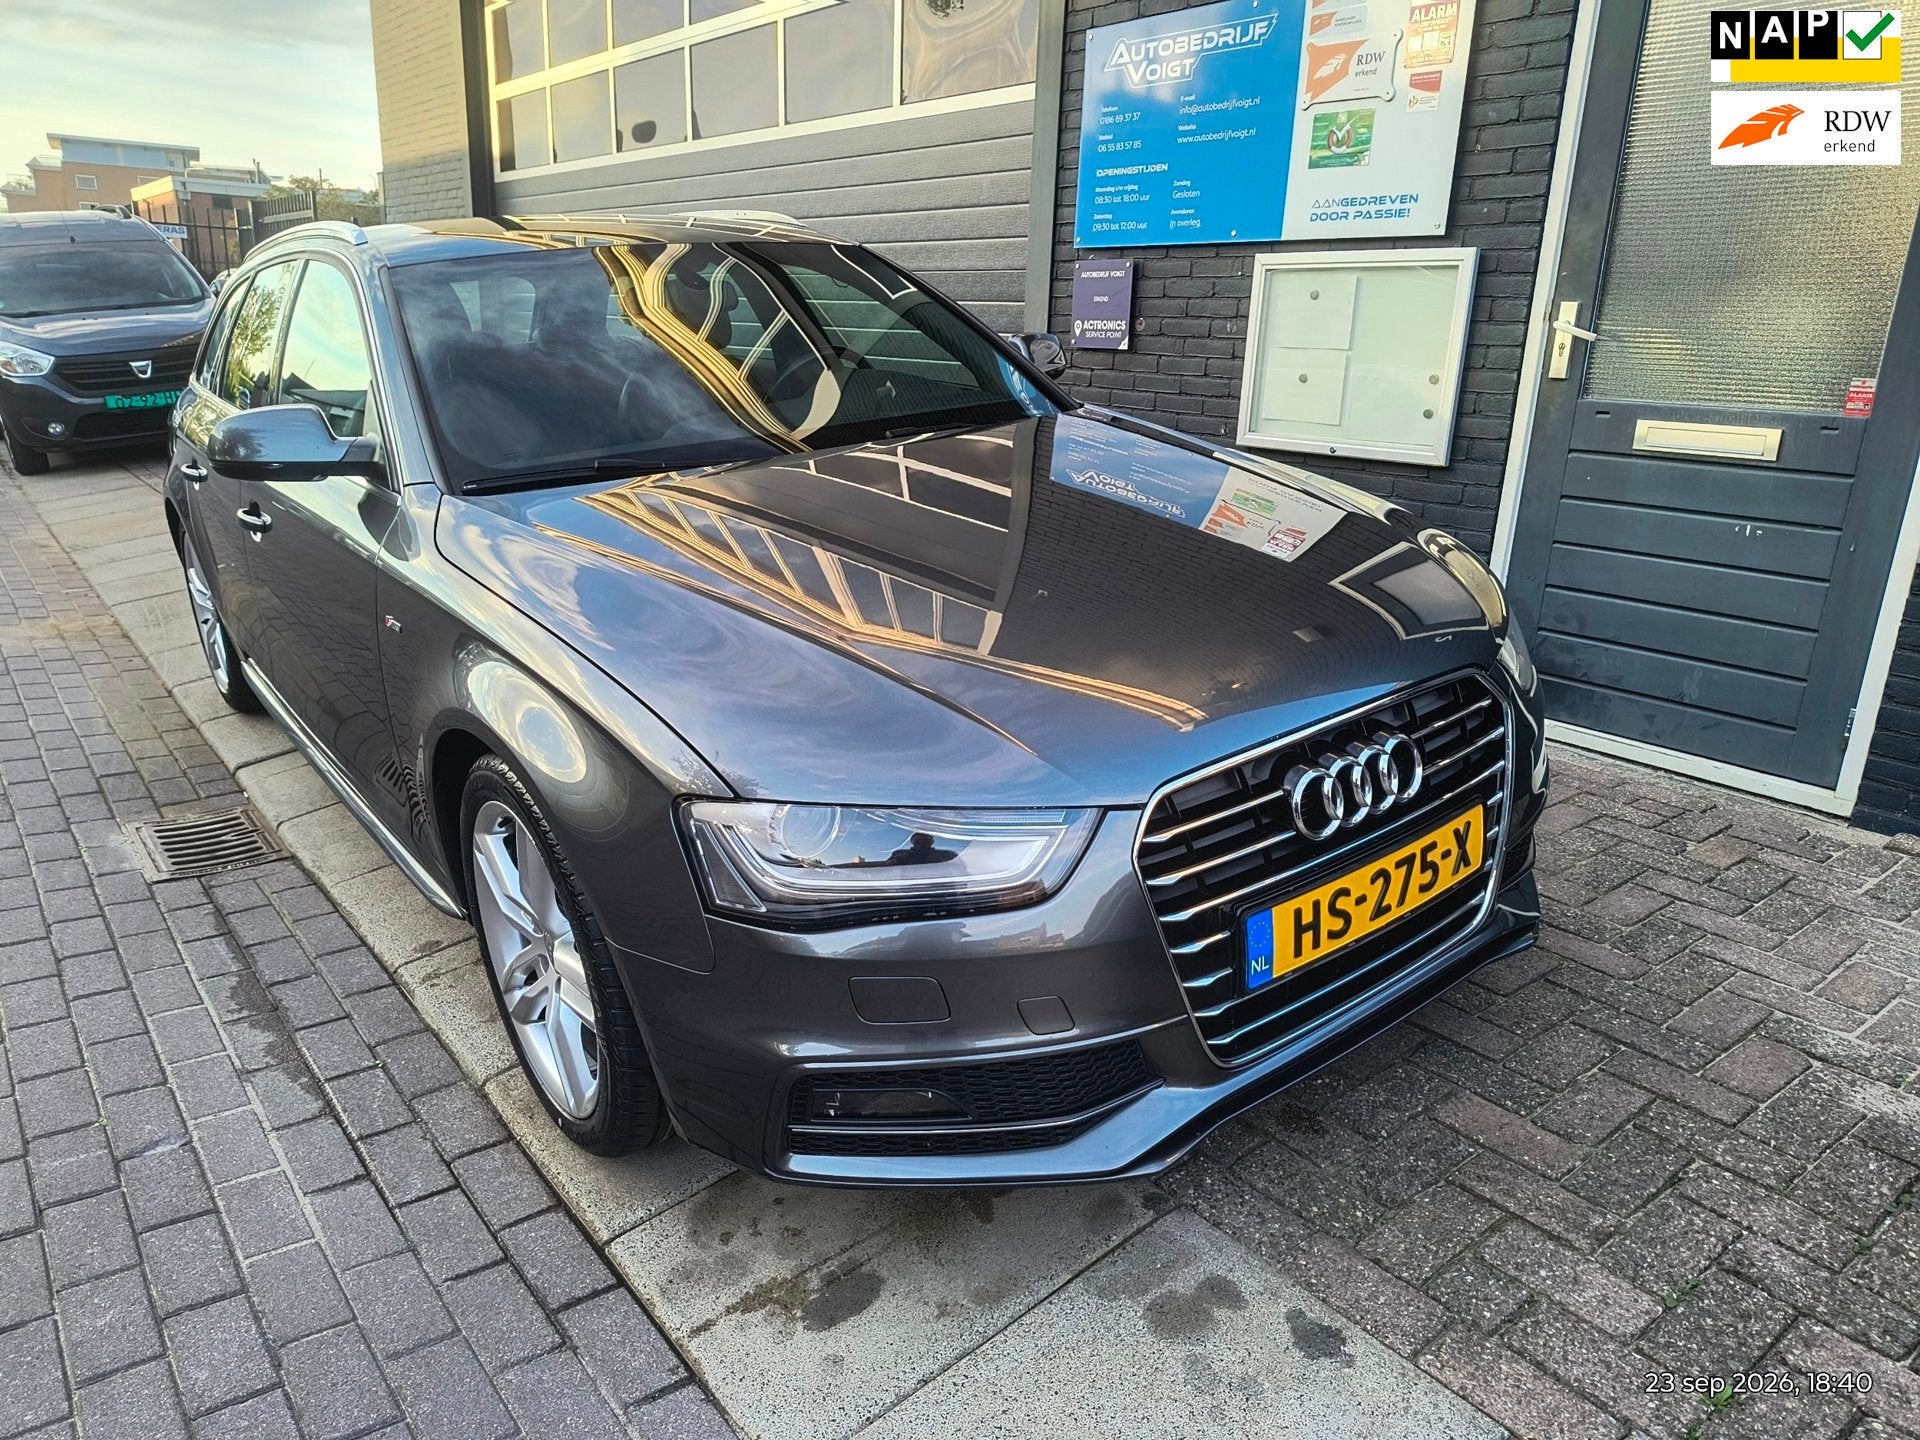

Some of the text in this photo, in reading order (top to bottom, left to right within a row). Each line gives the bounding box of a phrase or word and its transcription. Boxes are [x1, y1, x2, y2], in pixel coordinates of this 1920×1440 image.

[1411, 3, 1458, 22] ALARM
[1110, 21, 1270, 66] AUTOBEDRIJF
[1356, 51, 1386, 66] RDW
[1127, 58, 1197, 84] VOIGT
[1354, 67, 1378, 78] erkend
[1179, 96, 1261, 115] info@autobedrijfvoigt.nl
[1099, 112, 1141, 125] 0186 69 37 37
[1177, 127, 1257, 144] www.autobedrijfvoigt.nl
[1097, 140, 1142, 153] 06 55 83 57 85
[1096, 163, 1168, 177] OPENINGSTIJDEN
[1094, 195, 1112, 205] 08:30
[1112, 195, 1122, 203] tot
[1122, 193, 1139, 203] 18:00
[1172, 190, 1201, 199] Gesloten
[1311, 193, 1419, 209] AANGEDREVEN
[1309, 208, 1411, 222] DOOR PASSIE!
[1092, 222, 1110, 232] 09:30
[1110, 222, 1120, 230] tot
[1119, 221, 1137, 230] 12:00
[1176, 218, 1201, 229] overleg
[1110, 270, 1125, 278] VOIGT
[1083, 320, 1126, 330] ACTRONICS
[1293, 820, 1472, 959] HS-275-X
[1251, 955, 1270, 976] NL
